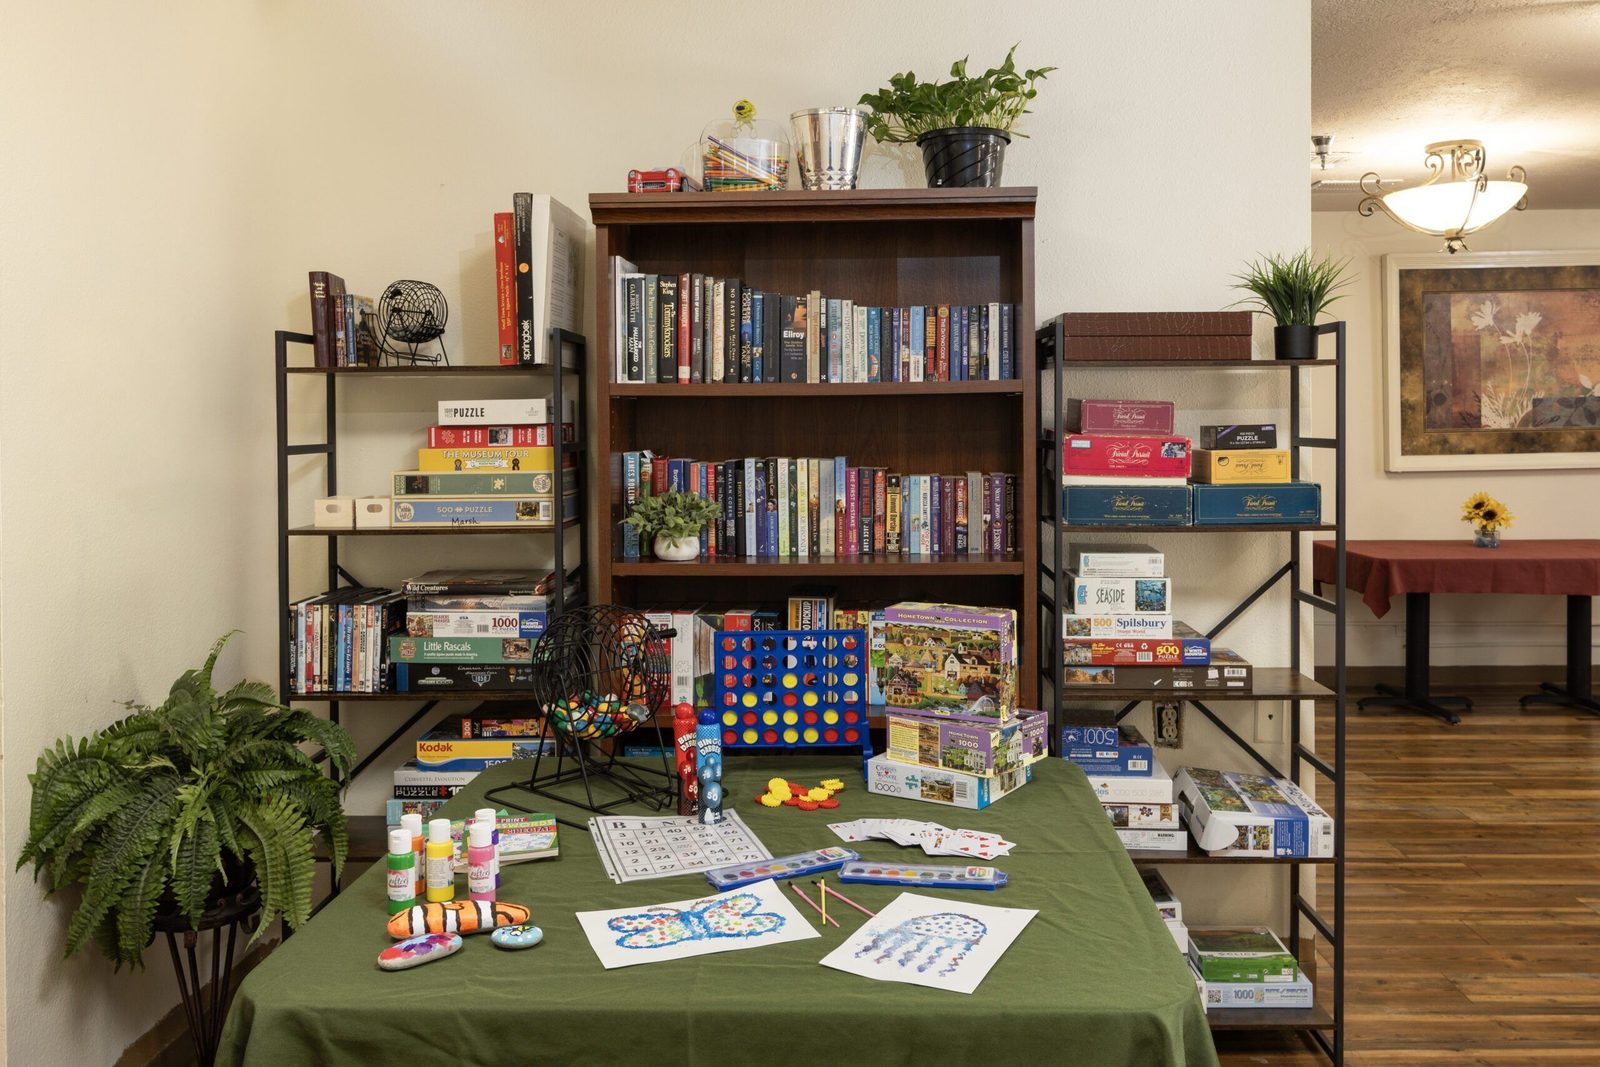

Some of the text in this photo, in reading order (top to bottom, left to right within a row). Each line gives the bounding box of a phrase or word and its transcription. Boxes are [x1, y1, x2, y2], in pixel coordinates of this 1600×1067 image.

[730, 288, 736, 298] NO
[663, 303, 674, 358] Tommyknockers
[783, 331, 805, 340] Ellroy
[521, 320, 532, 360] springbok
[454, 408, 485, 418] PUZZLE
[443, 450, 529, 460] THE MUSEUM TOUR
[1111, 448, 1150, 458] Trivial Pursuit
[452, 518, 480, 526] Marsh
[1096, 588, 1124, 604] SEASIDE
[802, 602, 811, 624] PICKUP
[898, 612, 988, 624] HOMETOWN COLLECTION
[492, 618, 518, 628] 1000
[1094, 618, 1166, 630] 500 Spilsbury
[424, 642, 472, 651] Little Rascals
[1156, 646, 1180, 656] 500
[948, 731, 978, 739] HOMETOWN
[1087, 730, 1115, 746] 500
[419, 742, 454, 752] Kodak
[698, 738, 722, 751] BINGO
[959, 740, 979, 748] 1000
[689, 785, 698, 794] 50
[707, 792, 718, 801] 50
[1234, 990, 1254, 999] 1000
